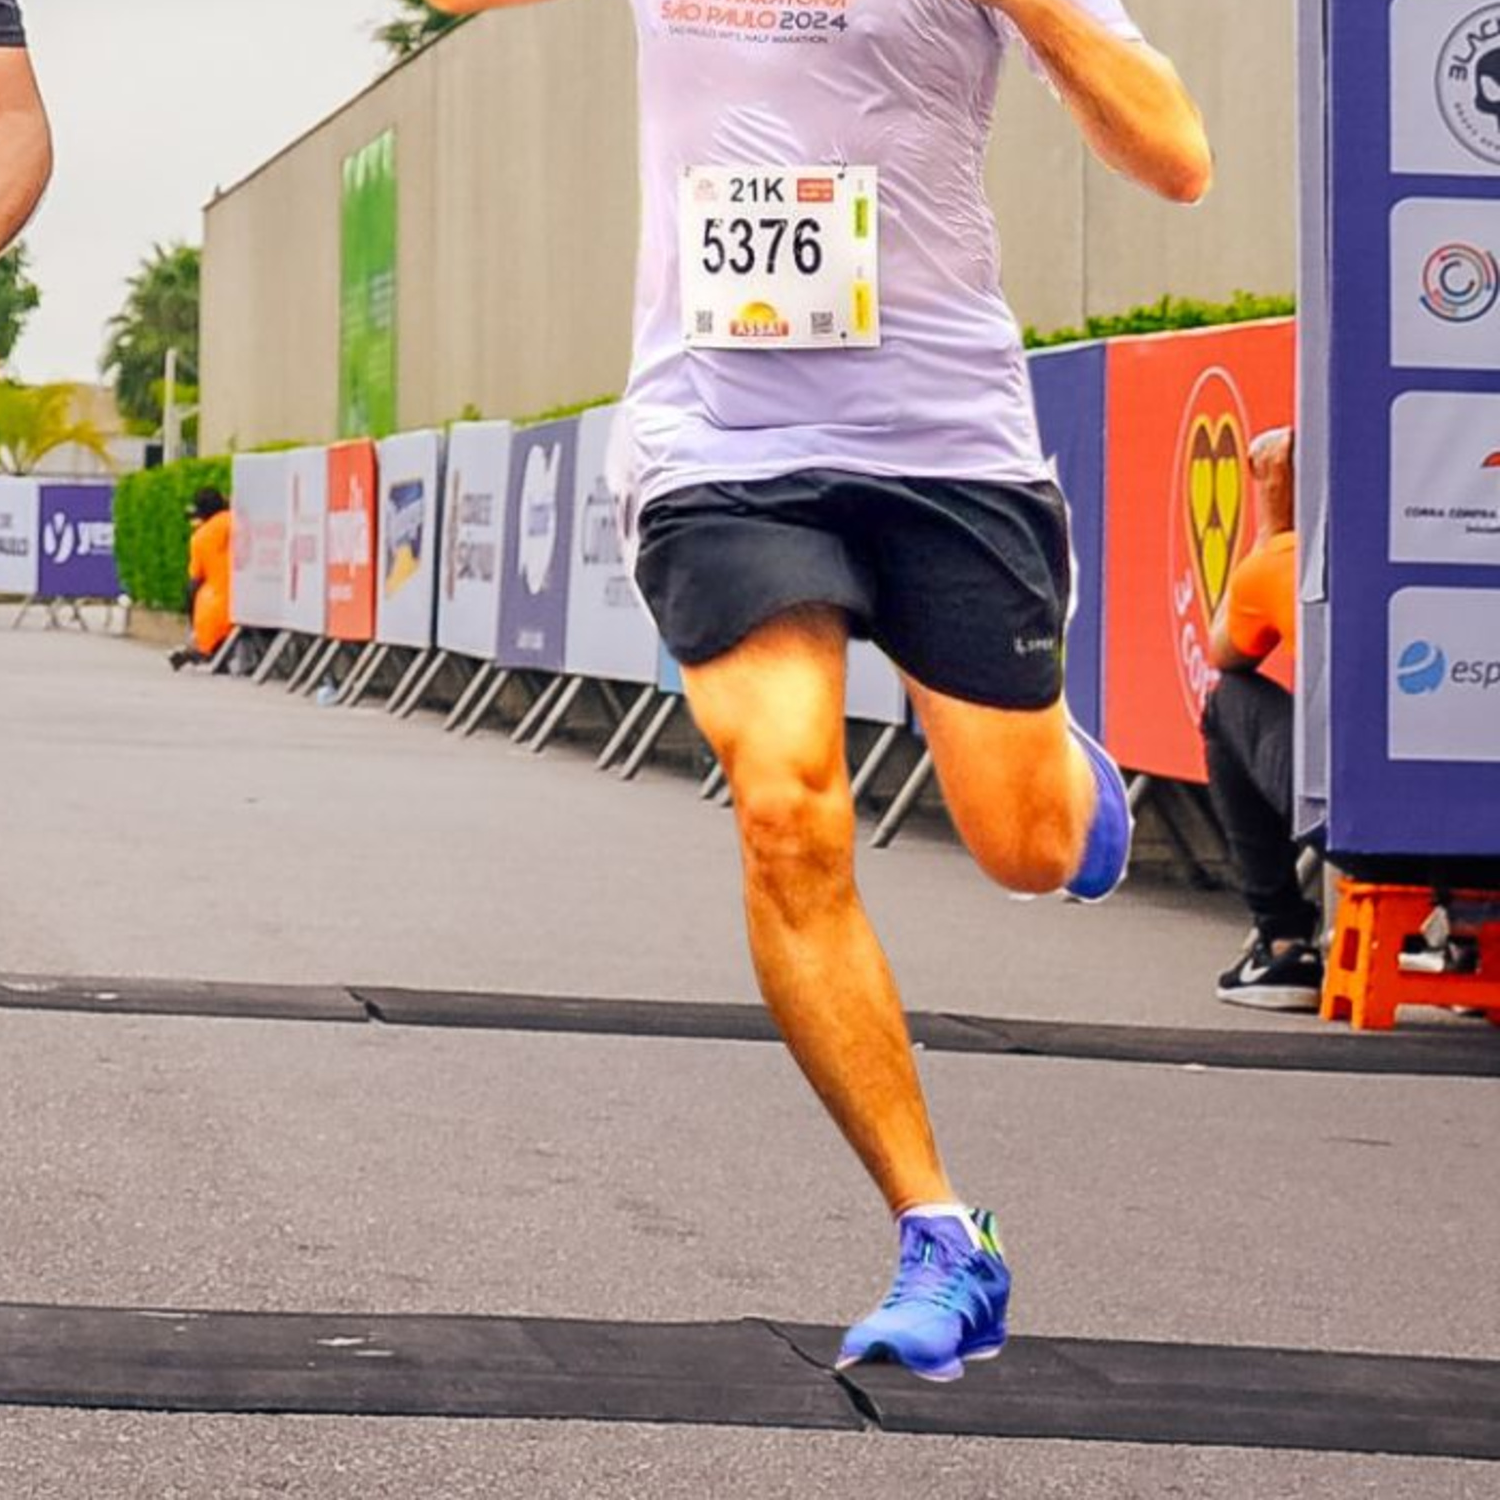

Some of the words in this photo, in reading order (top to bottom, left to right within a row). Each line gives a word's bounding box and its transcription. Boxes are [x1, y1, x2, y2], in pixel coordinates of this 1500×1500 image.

[706, 5, 777, 30] PAULO
[779, 10, 849, 33] 2024
[729, 177, 785, 203] 21K
[702, 218, 823, 276] 5376
